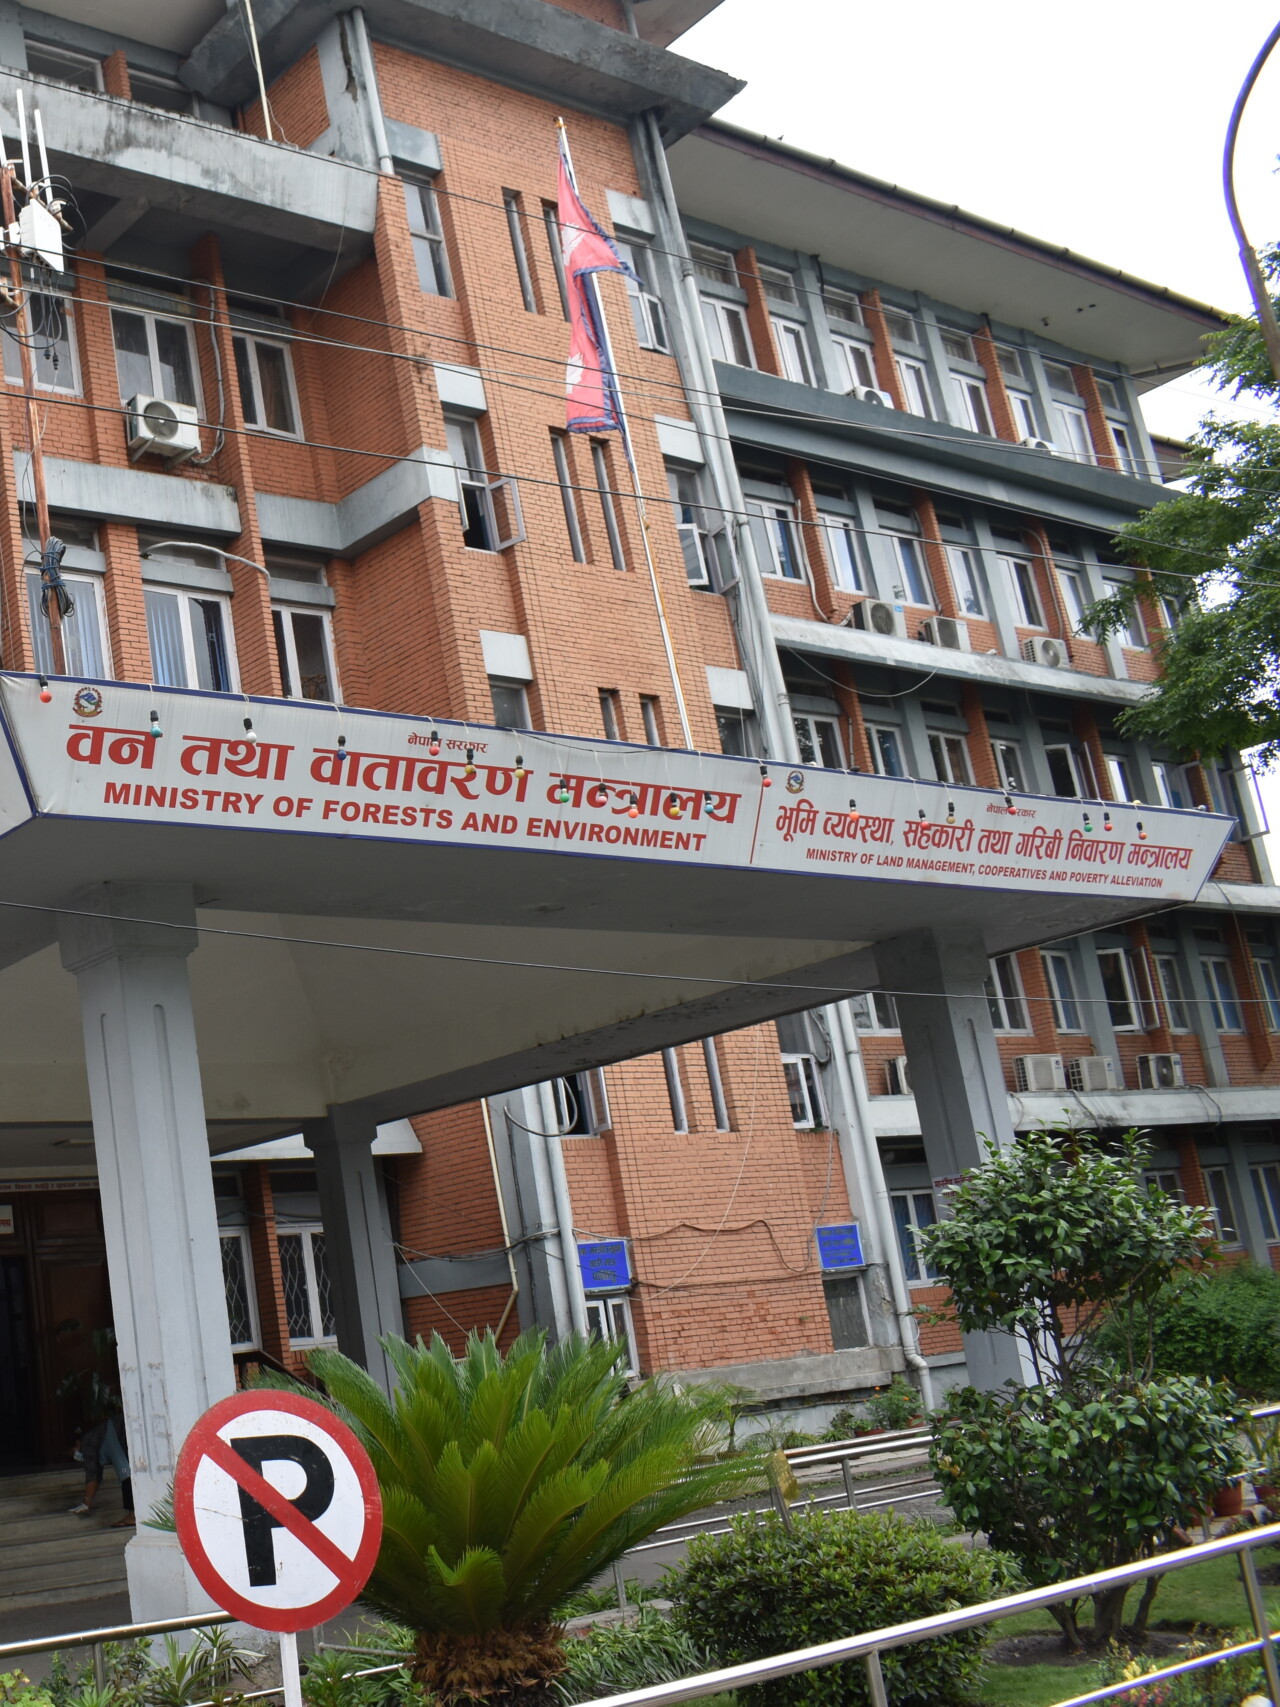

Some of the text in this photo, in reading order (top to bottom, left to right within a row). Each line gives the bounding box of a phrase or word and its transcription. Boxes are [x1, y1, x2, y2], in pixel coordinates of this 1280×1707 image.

[66, 724, 742, 824] वन तथा वातावरण मन्त्रालय
[104, 782, 706, 851] MINISTRY OF FORESTS AND ENVIRONMENT
[776, 798, 1193, 870] भूमि व्यवस्था, सहकारी तथा गरिबी निवारण मन्त्रालय
[986, 803, 1037, 818] नेपाल रकार
[806, 848, 1163, 888] MINISTRY OF LAND MANAGEMENT, COOPERATIVES AND POVERTY ALLEVIATION
[230, 1434, 335, 1588] P
